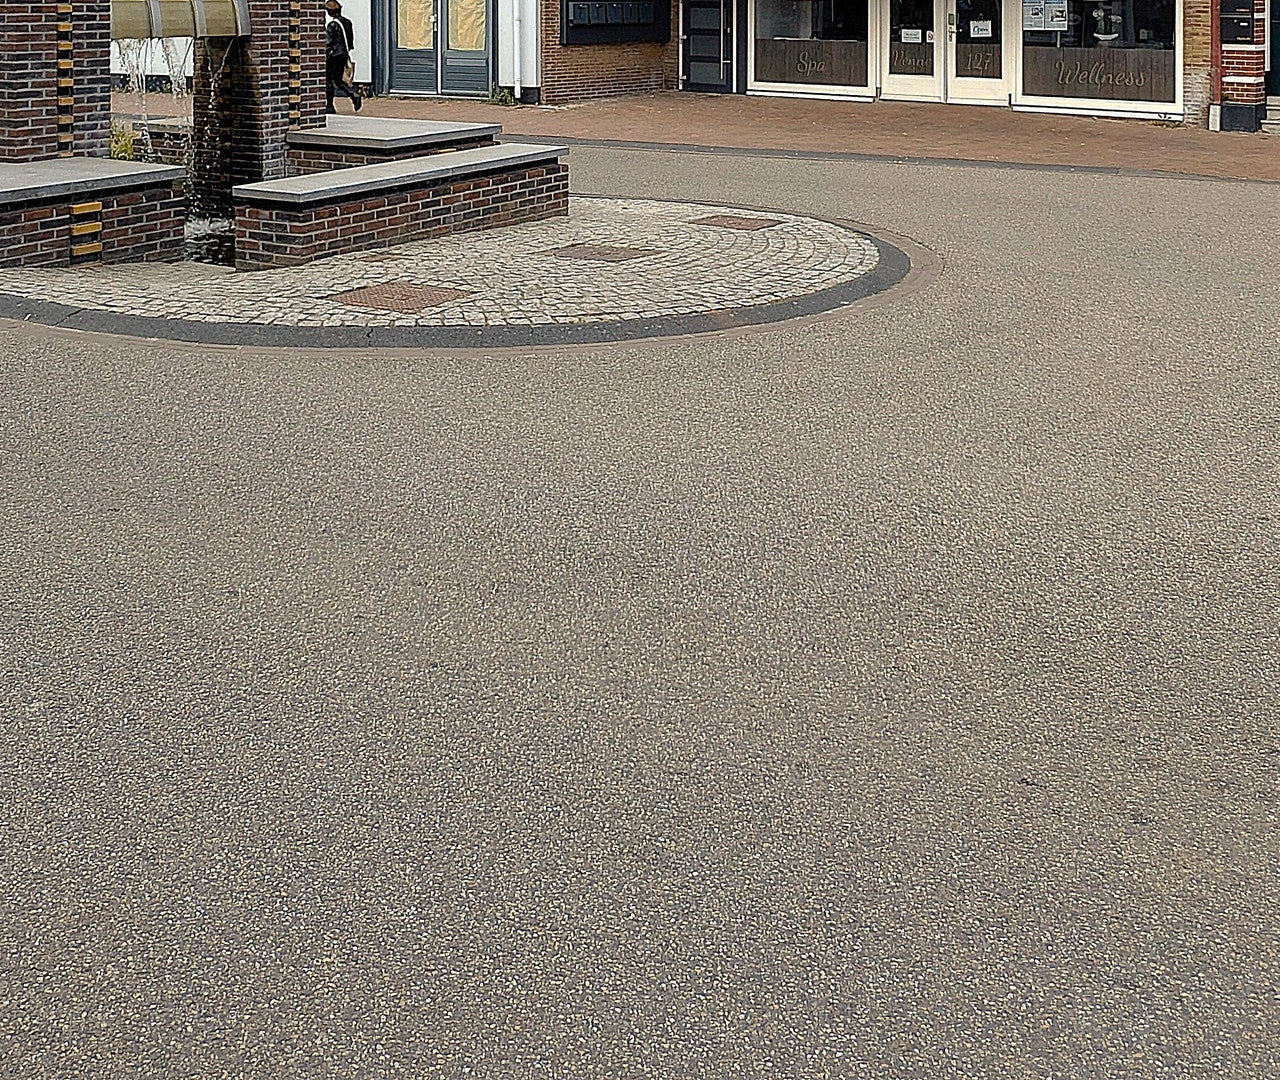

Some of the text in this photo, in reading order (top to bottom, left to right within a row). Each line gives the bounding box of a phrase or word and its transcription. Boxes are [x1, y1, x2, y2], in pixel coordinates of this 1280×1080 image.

[797, 52, 825, 76] Spa
[965, 53, 993, 70] 127
[1055, 61, 1145, 87] Wellness
